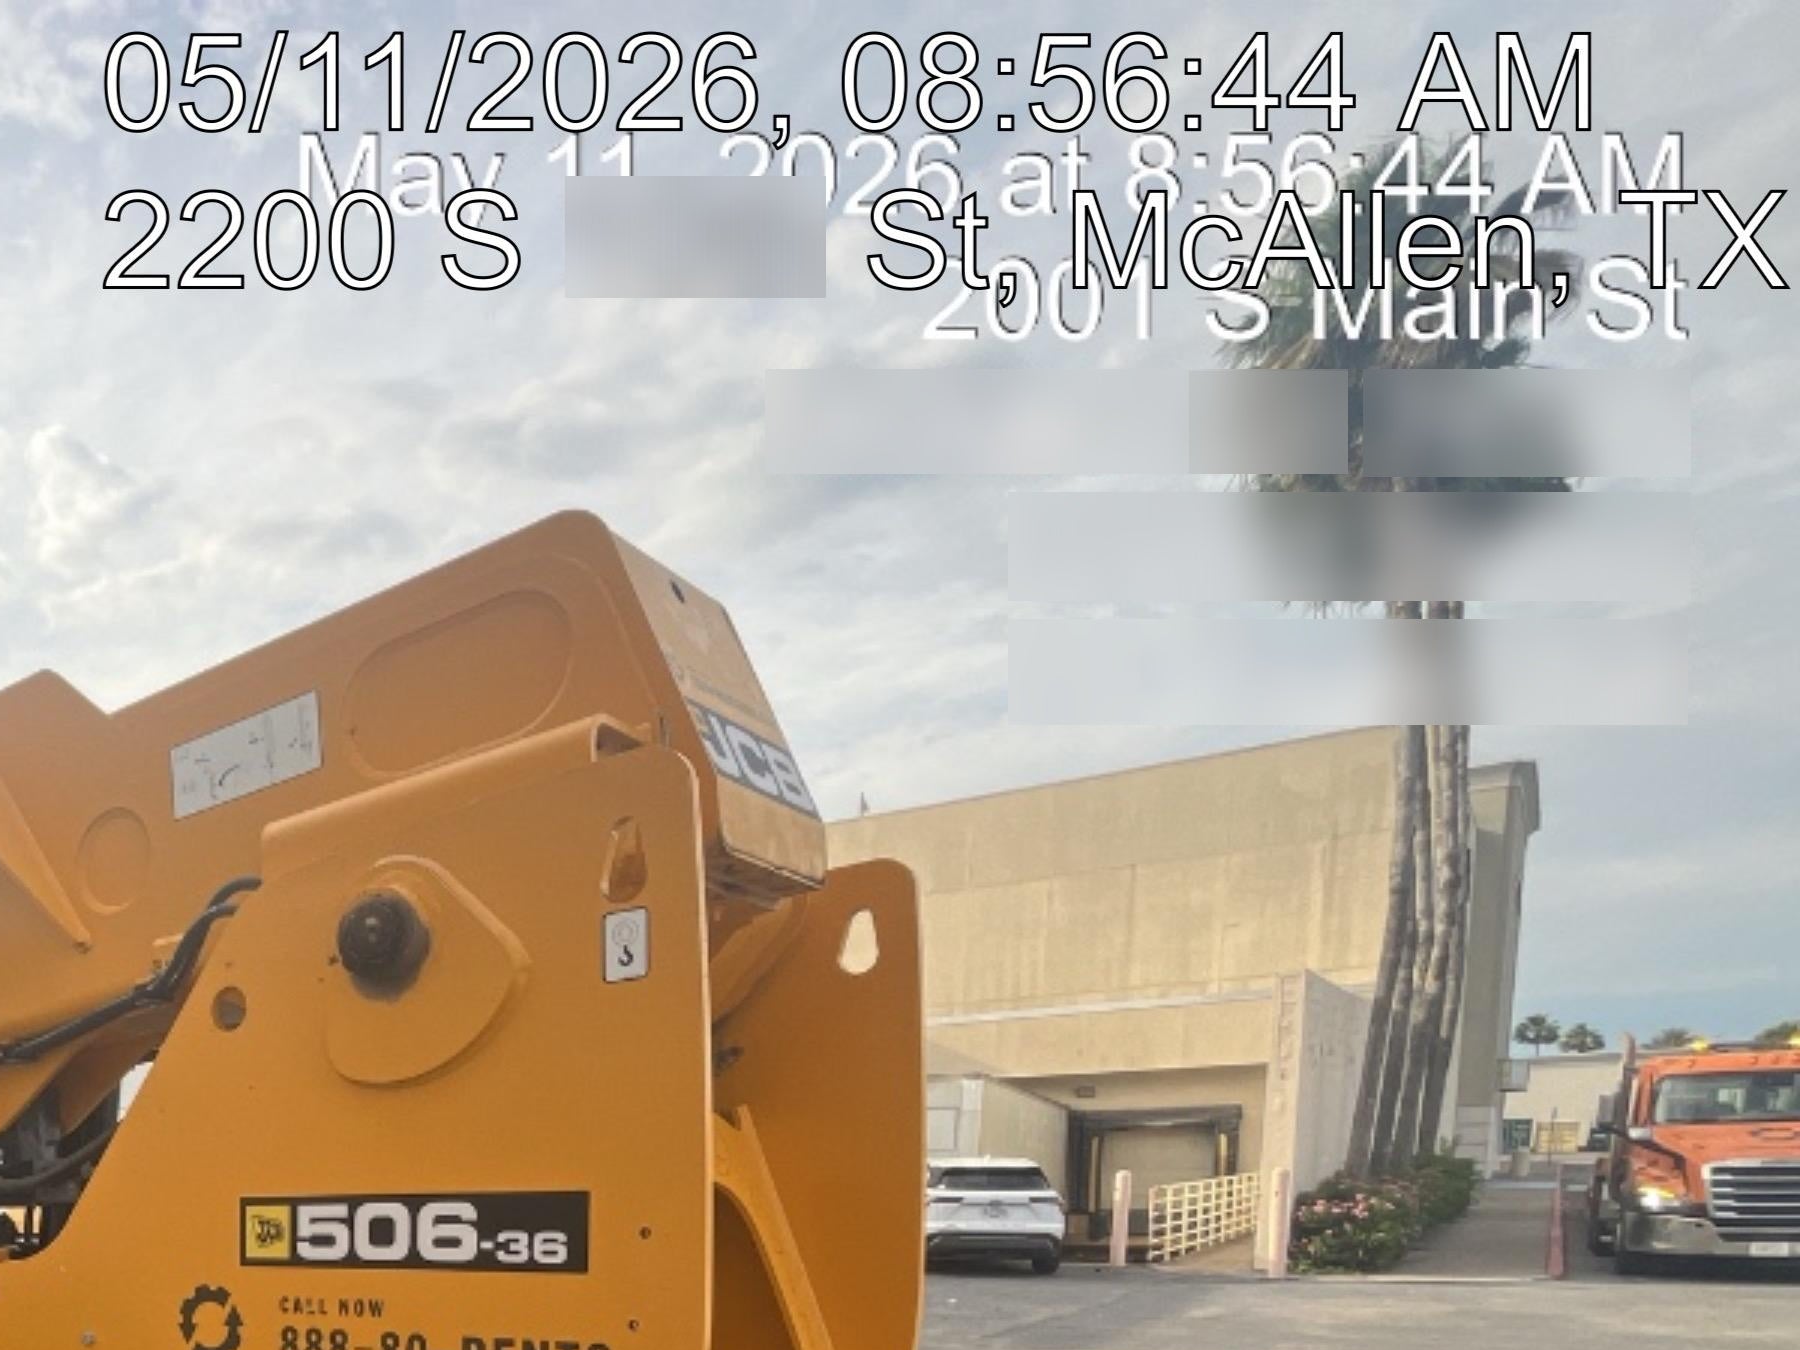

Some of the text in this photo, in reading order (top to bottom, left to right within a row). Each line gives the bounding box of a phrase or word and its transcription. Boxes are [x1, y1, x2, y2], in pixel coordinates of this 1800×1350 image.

[699, 706, 819, 816] JCB
[296, 1201, 568, 1264] 506-36
[279, 1296, 385, 1318] CALL NOW
